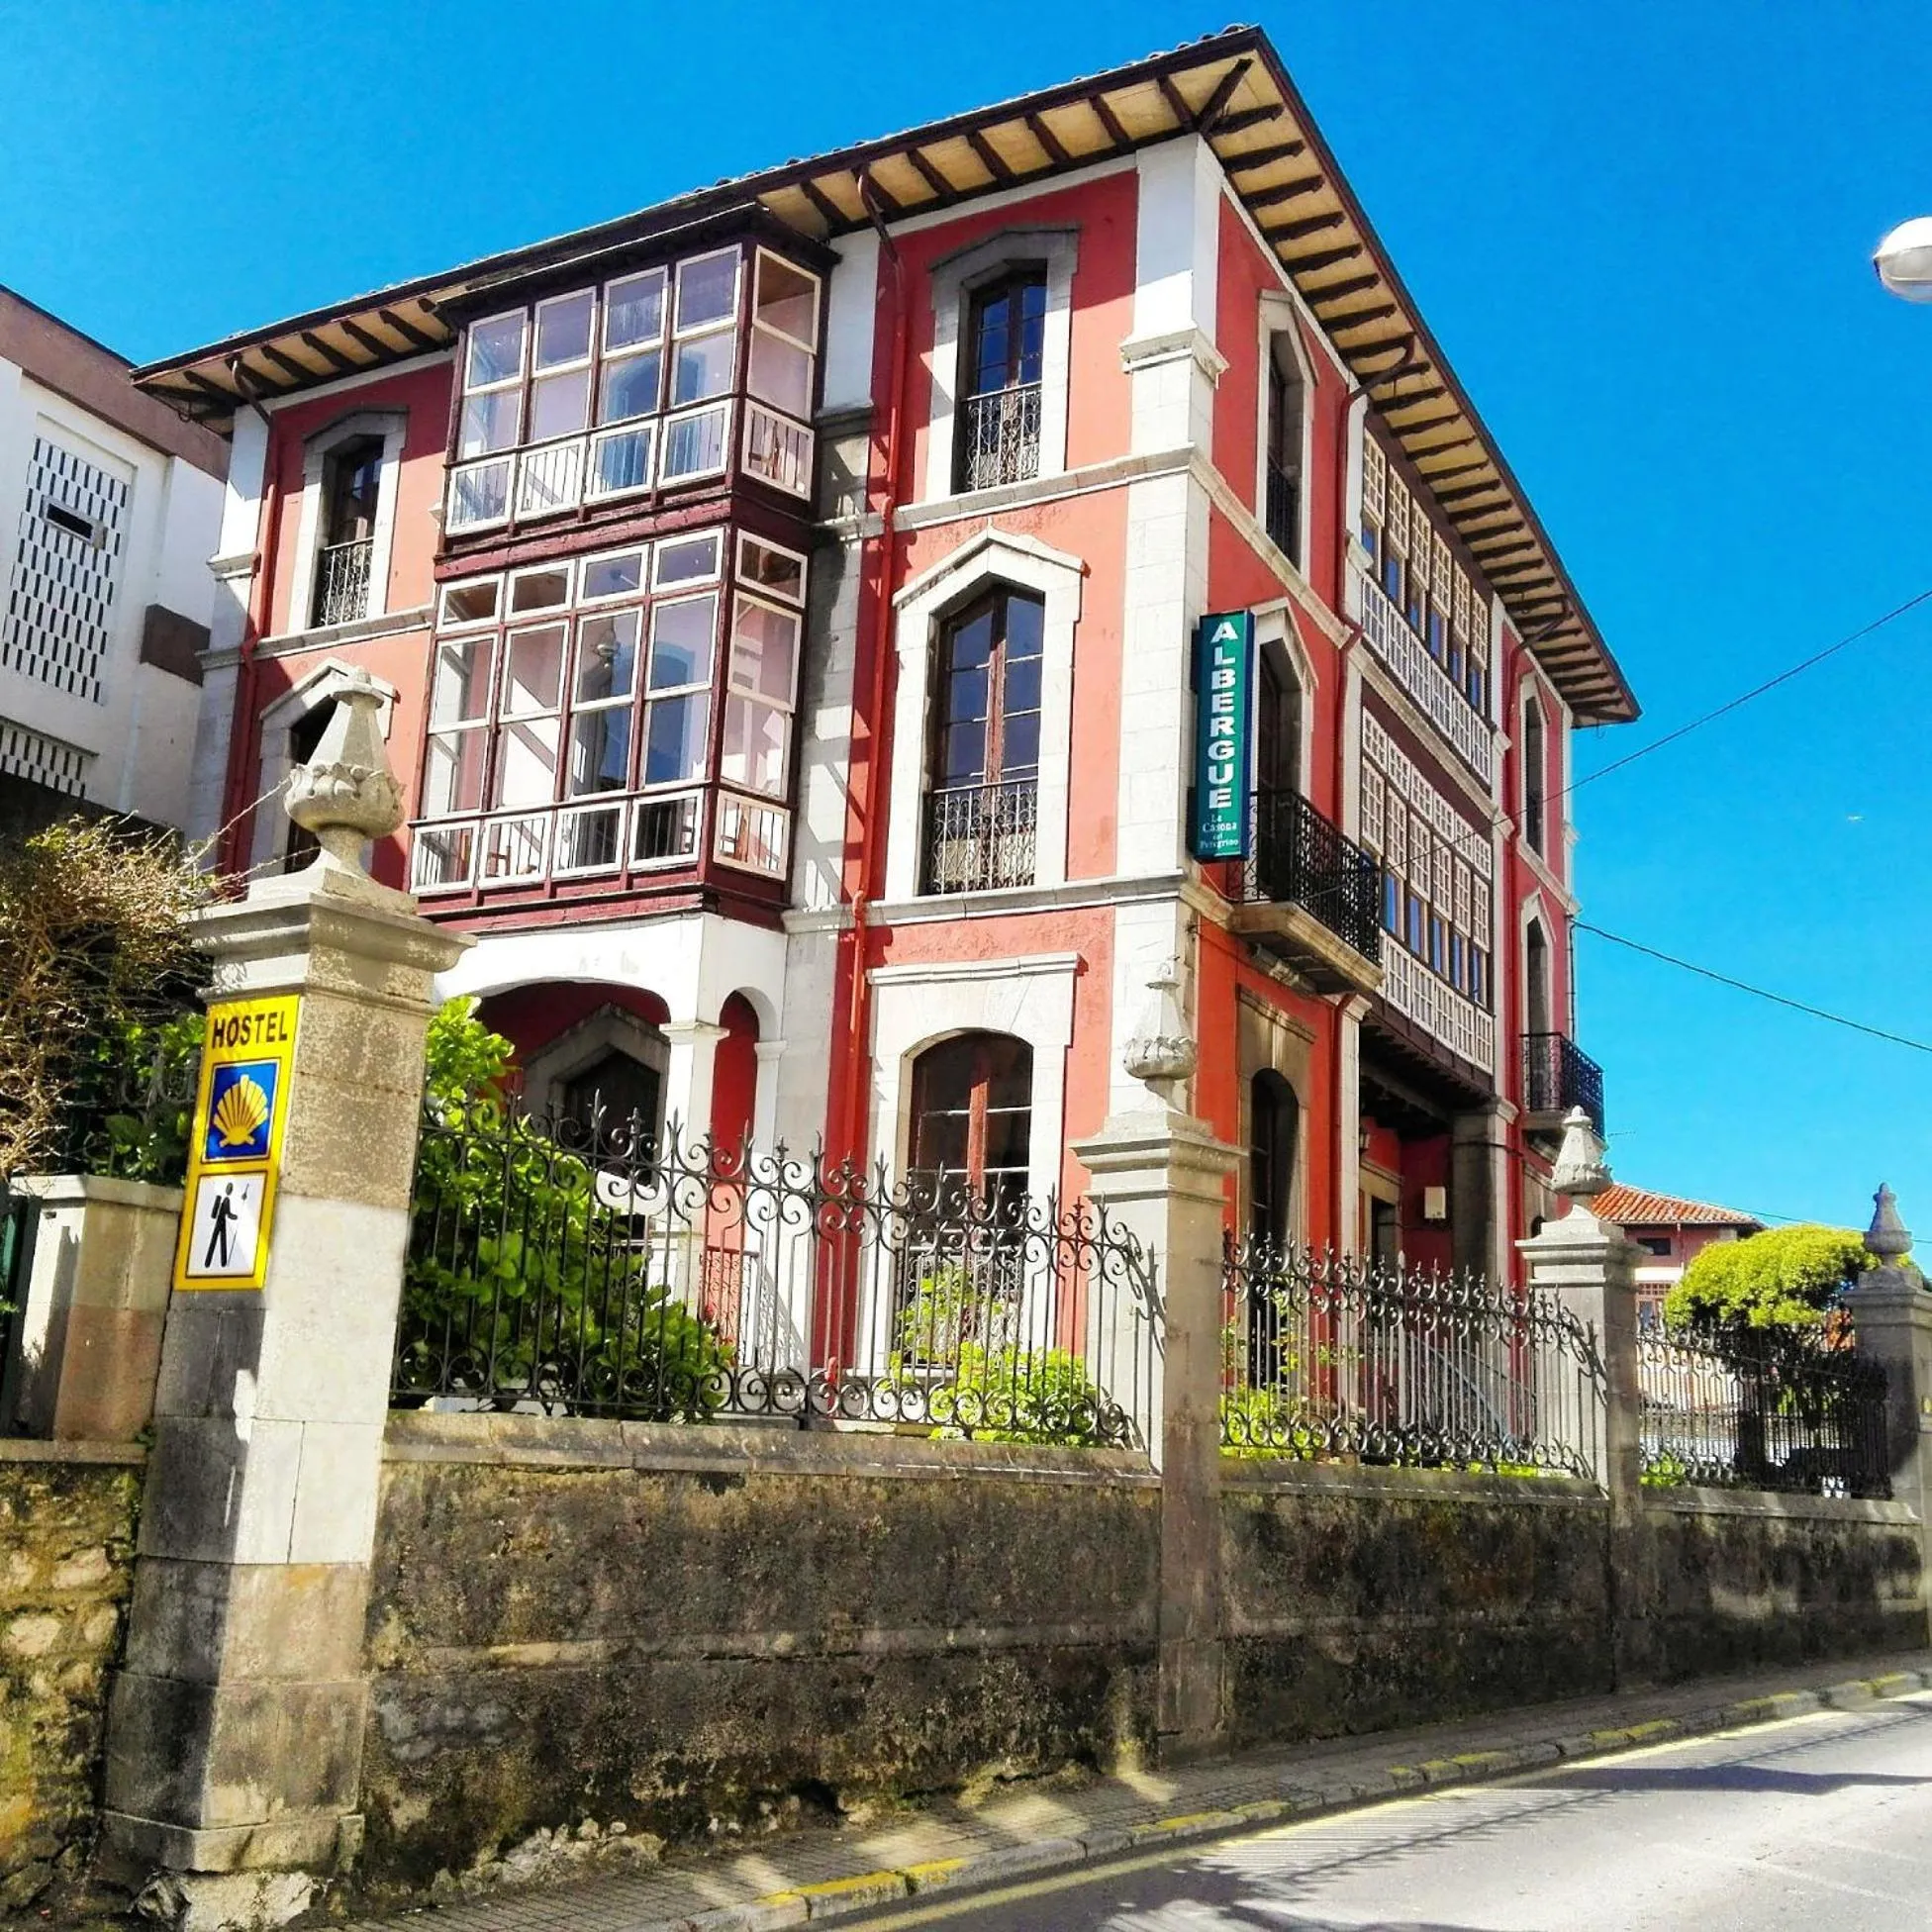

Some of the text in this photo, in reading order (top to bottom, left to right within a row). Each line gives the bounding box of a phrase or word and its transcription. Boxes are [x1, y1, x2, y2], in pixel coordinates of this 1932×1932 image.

[1208, 621, 1238, 809] ALBERGUE
[1203, 822, 1237, 832] Casona
[212, 1010, 288, 1049] HOSTEL
